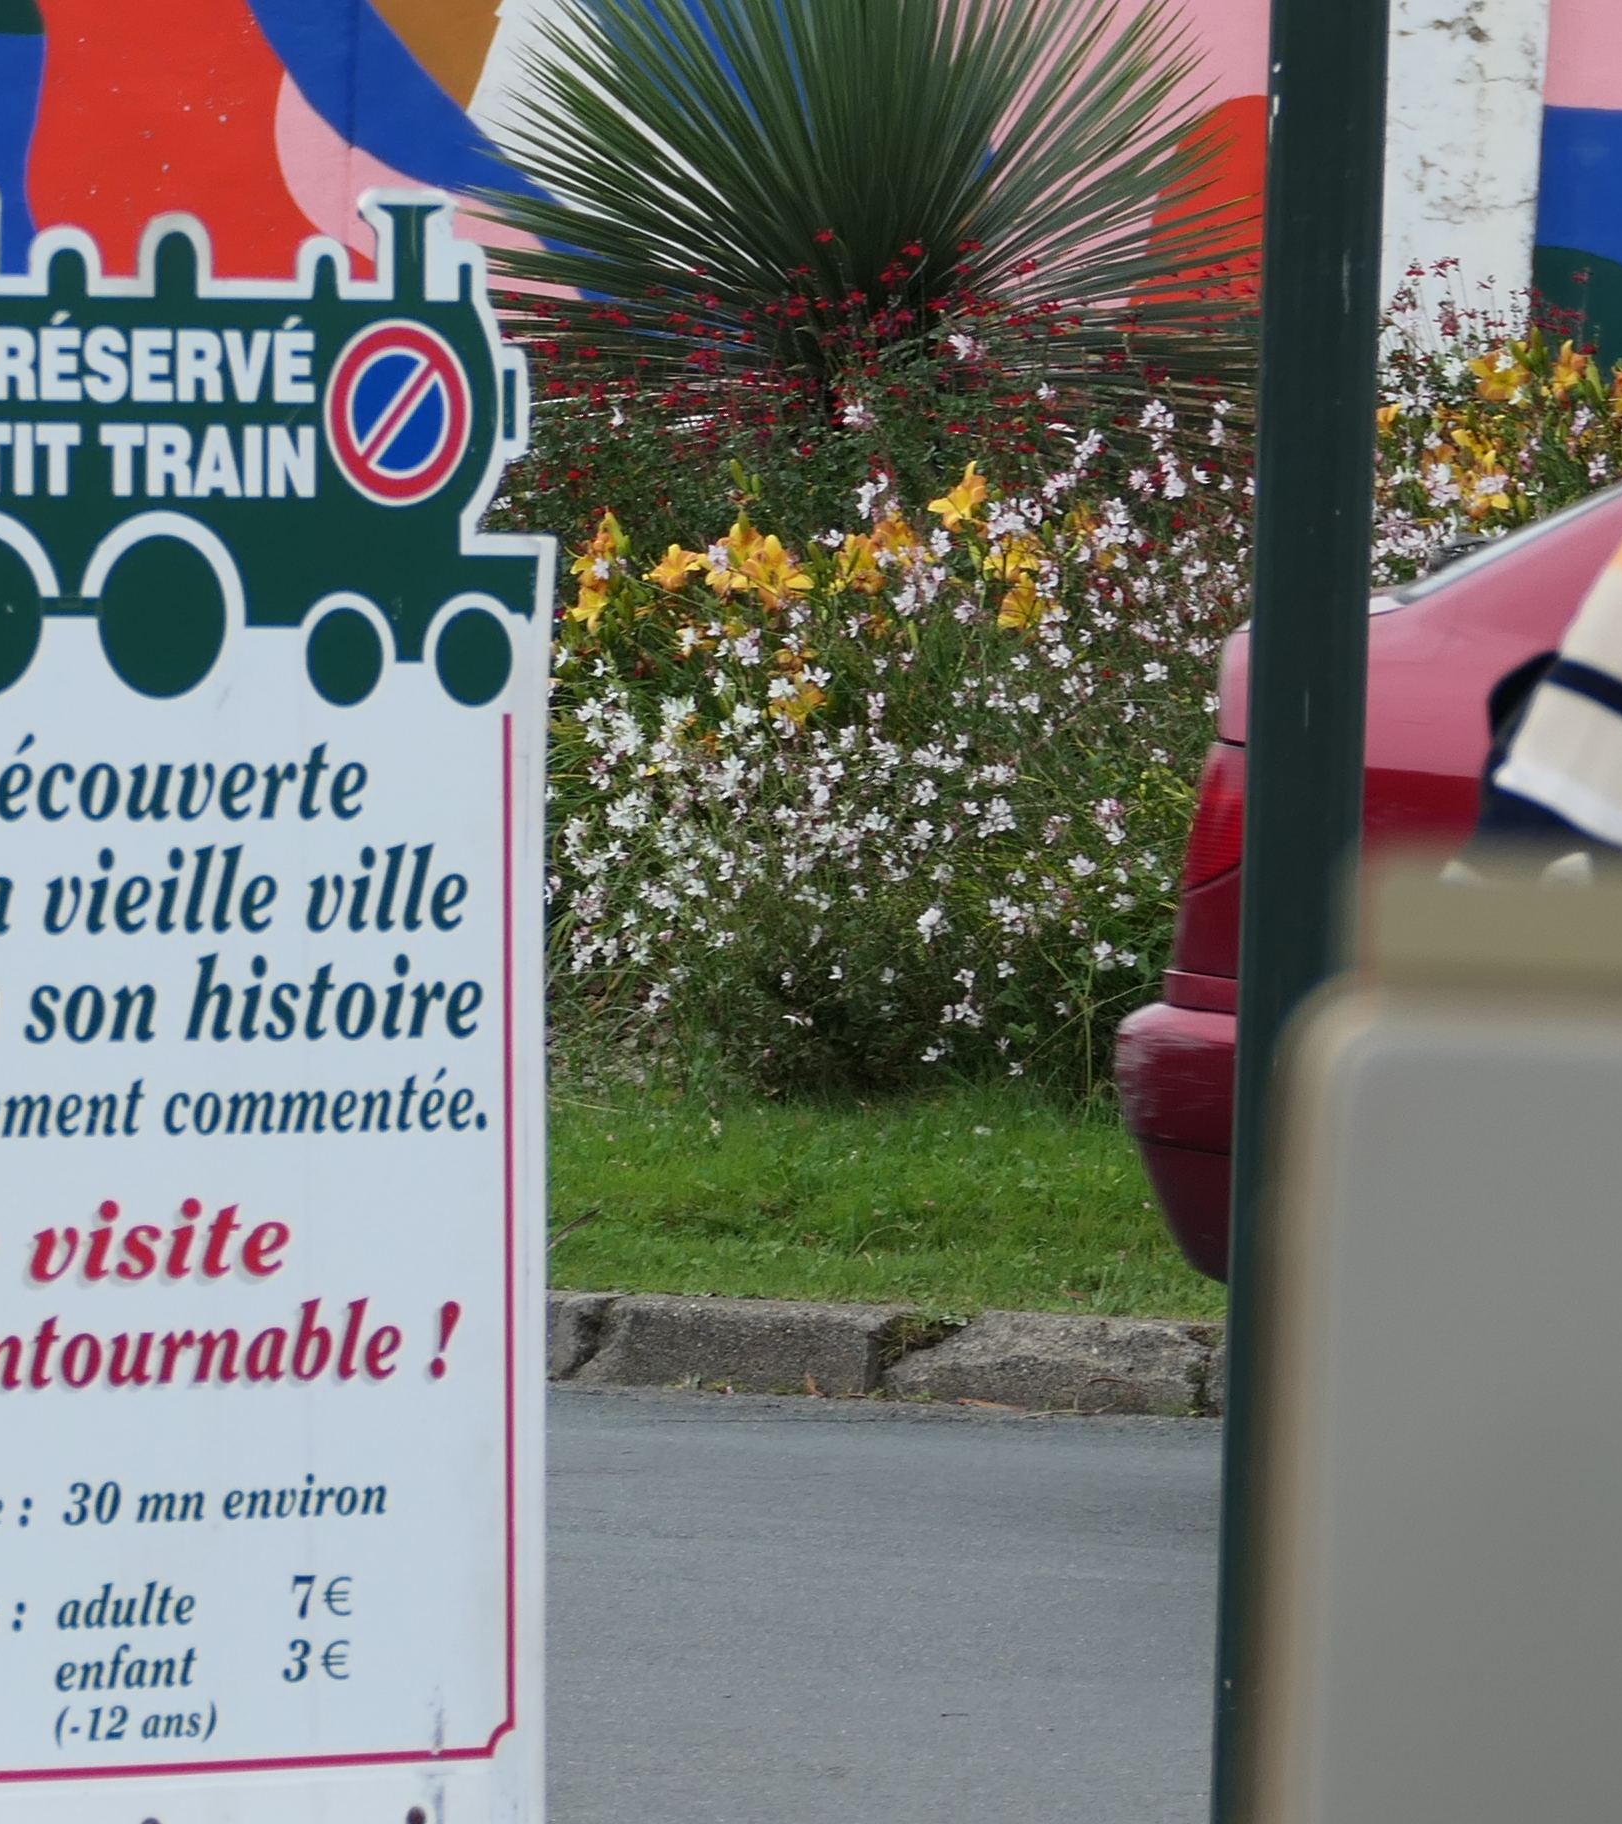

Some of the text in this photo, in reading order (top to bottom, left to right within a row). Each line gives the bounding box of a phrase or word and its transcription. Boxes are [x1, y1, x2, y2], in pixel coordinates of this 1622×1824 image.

[99, 424, 316, 498] TRAIN
[43, 844, 278, 936] vieille
[305, 842, 468, 934] ville
[23, 983, 157, 1045] son
[184, 952, 484, 1043] histoire
[163, 1066, 488, 1136] commentée.
[29, 1197, 290, 1283] visite
[63, 1480, 122, 1526] 30
[136, 1490, 205, 1523] mn
[222, 1472, 387, 1521] environ
[56, 1580, 196, 1631] adulte
[55, 1642, 197, 1692] enfant
[141, 1703, 217, 1741] ans)
